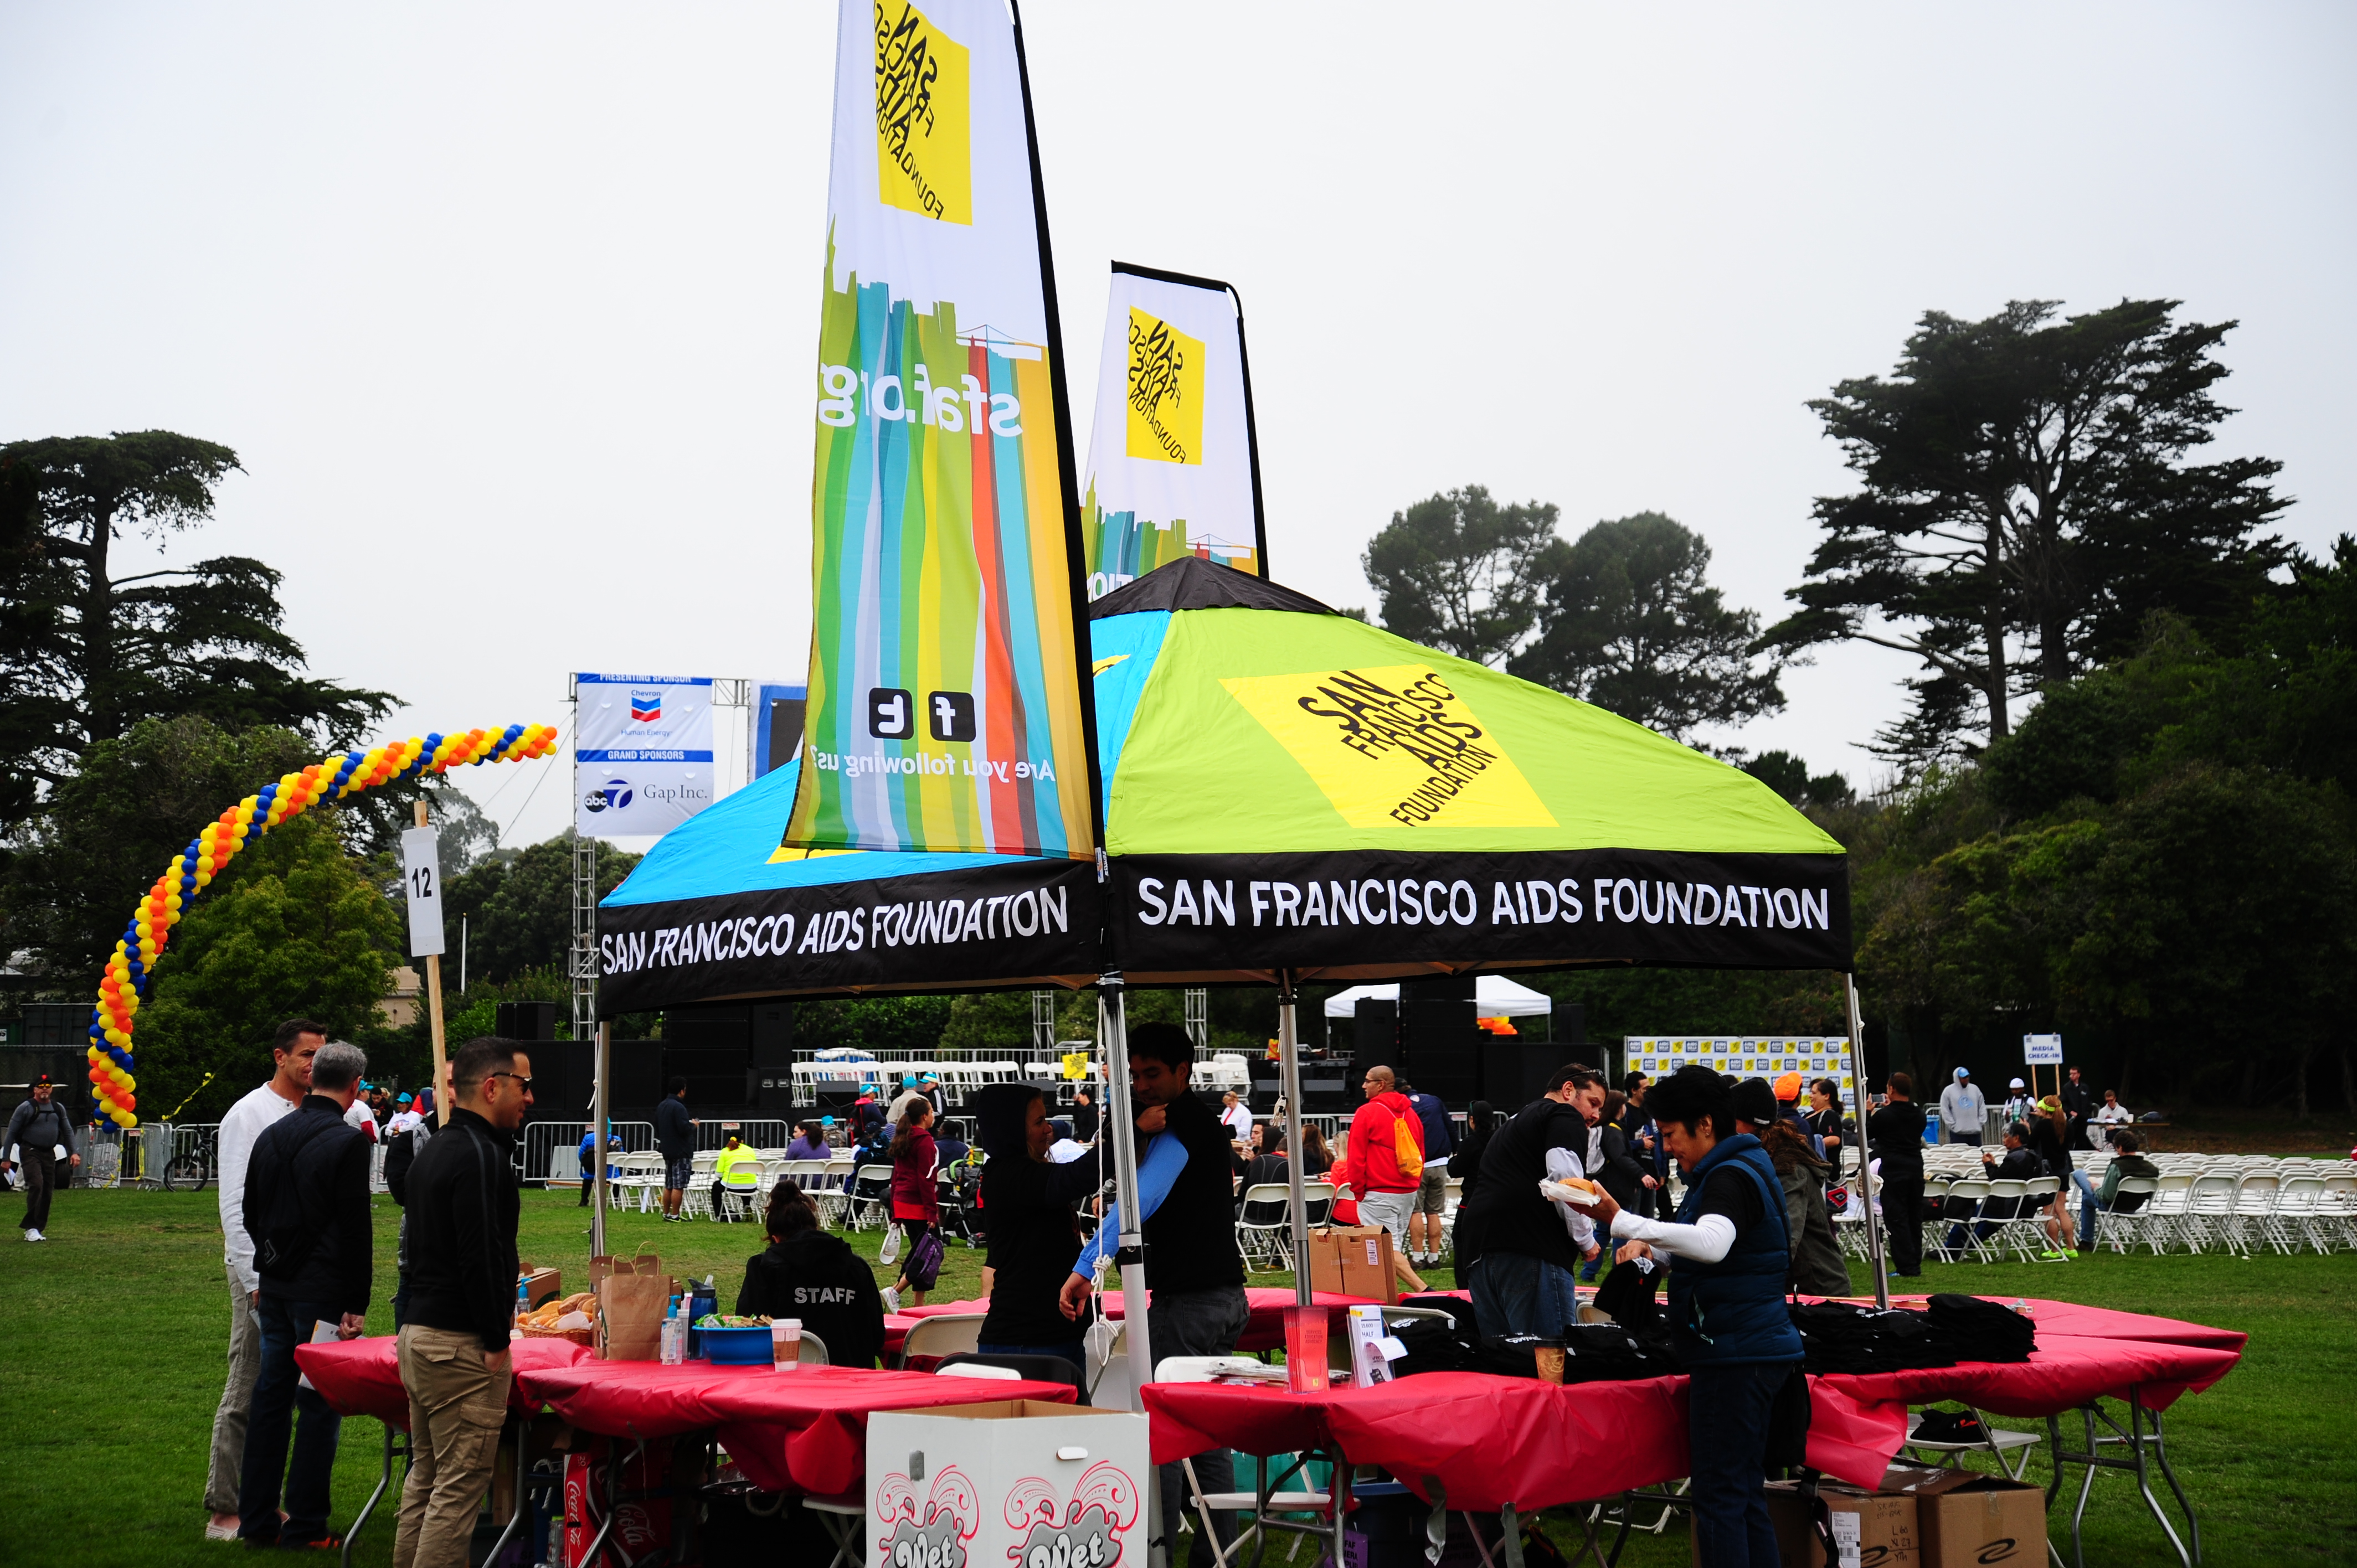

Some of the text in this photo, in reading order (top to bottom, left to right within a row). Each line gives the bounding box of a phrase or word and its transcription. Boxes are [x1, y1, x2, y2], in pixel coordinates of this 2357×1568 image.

[600, 674, 650, 682] PRESENTING
[1298, 670, 1400, 732] SAN
[1395, 713, 1482, 770] AIDS
[608, 750, 685, 760] GRAND SPONSORS
[644, 784, 707, 803] Gap Inc.
[1389, 744, 1497, 827] FOUNDATION
[584, 795, 608, 806] abc
[411, 866, 432, 899] 12
[1138, 878, 1829, 930] SAN FRANCISCO AIDS FOUNDATION
[601, 885, 1068, 975] SAN FRANCISCO AIDS FOUNDATION
[794, 1287, 856, 1305] STAFF
[579, 1455, 586, 1467] 20
[615, 1503, 657, 1545] Cola
[1892, 1525, 1898, 1536] L
[894, 1533, 954, 1568] Wet
[1026, 1531, 1105, 1568] Wet
[1345, 1540, 1356, 1549] FAF
[1901, 1538, 1911, 1548] 27
